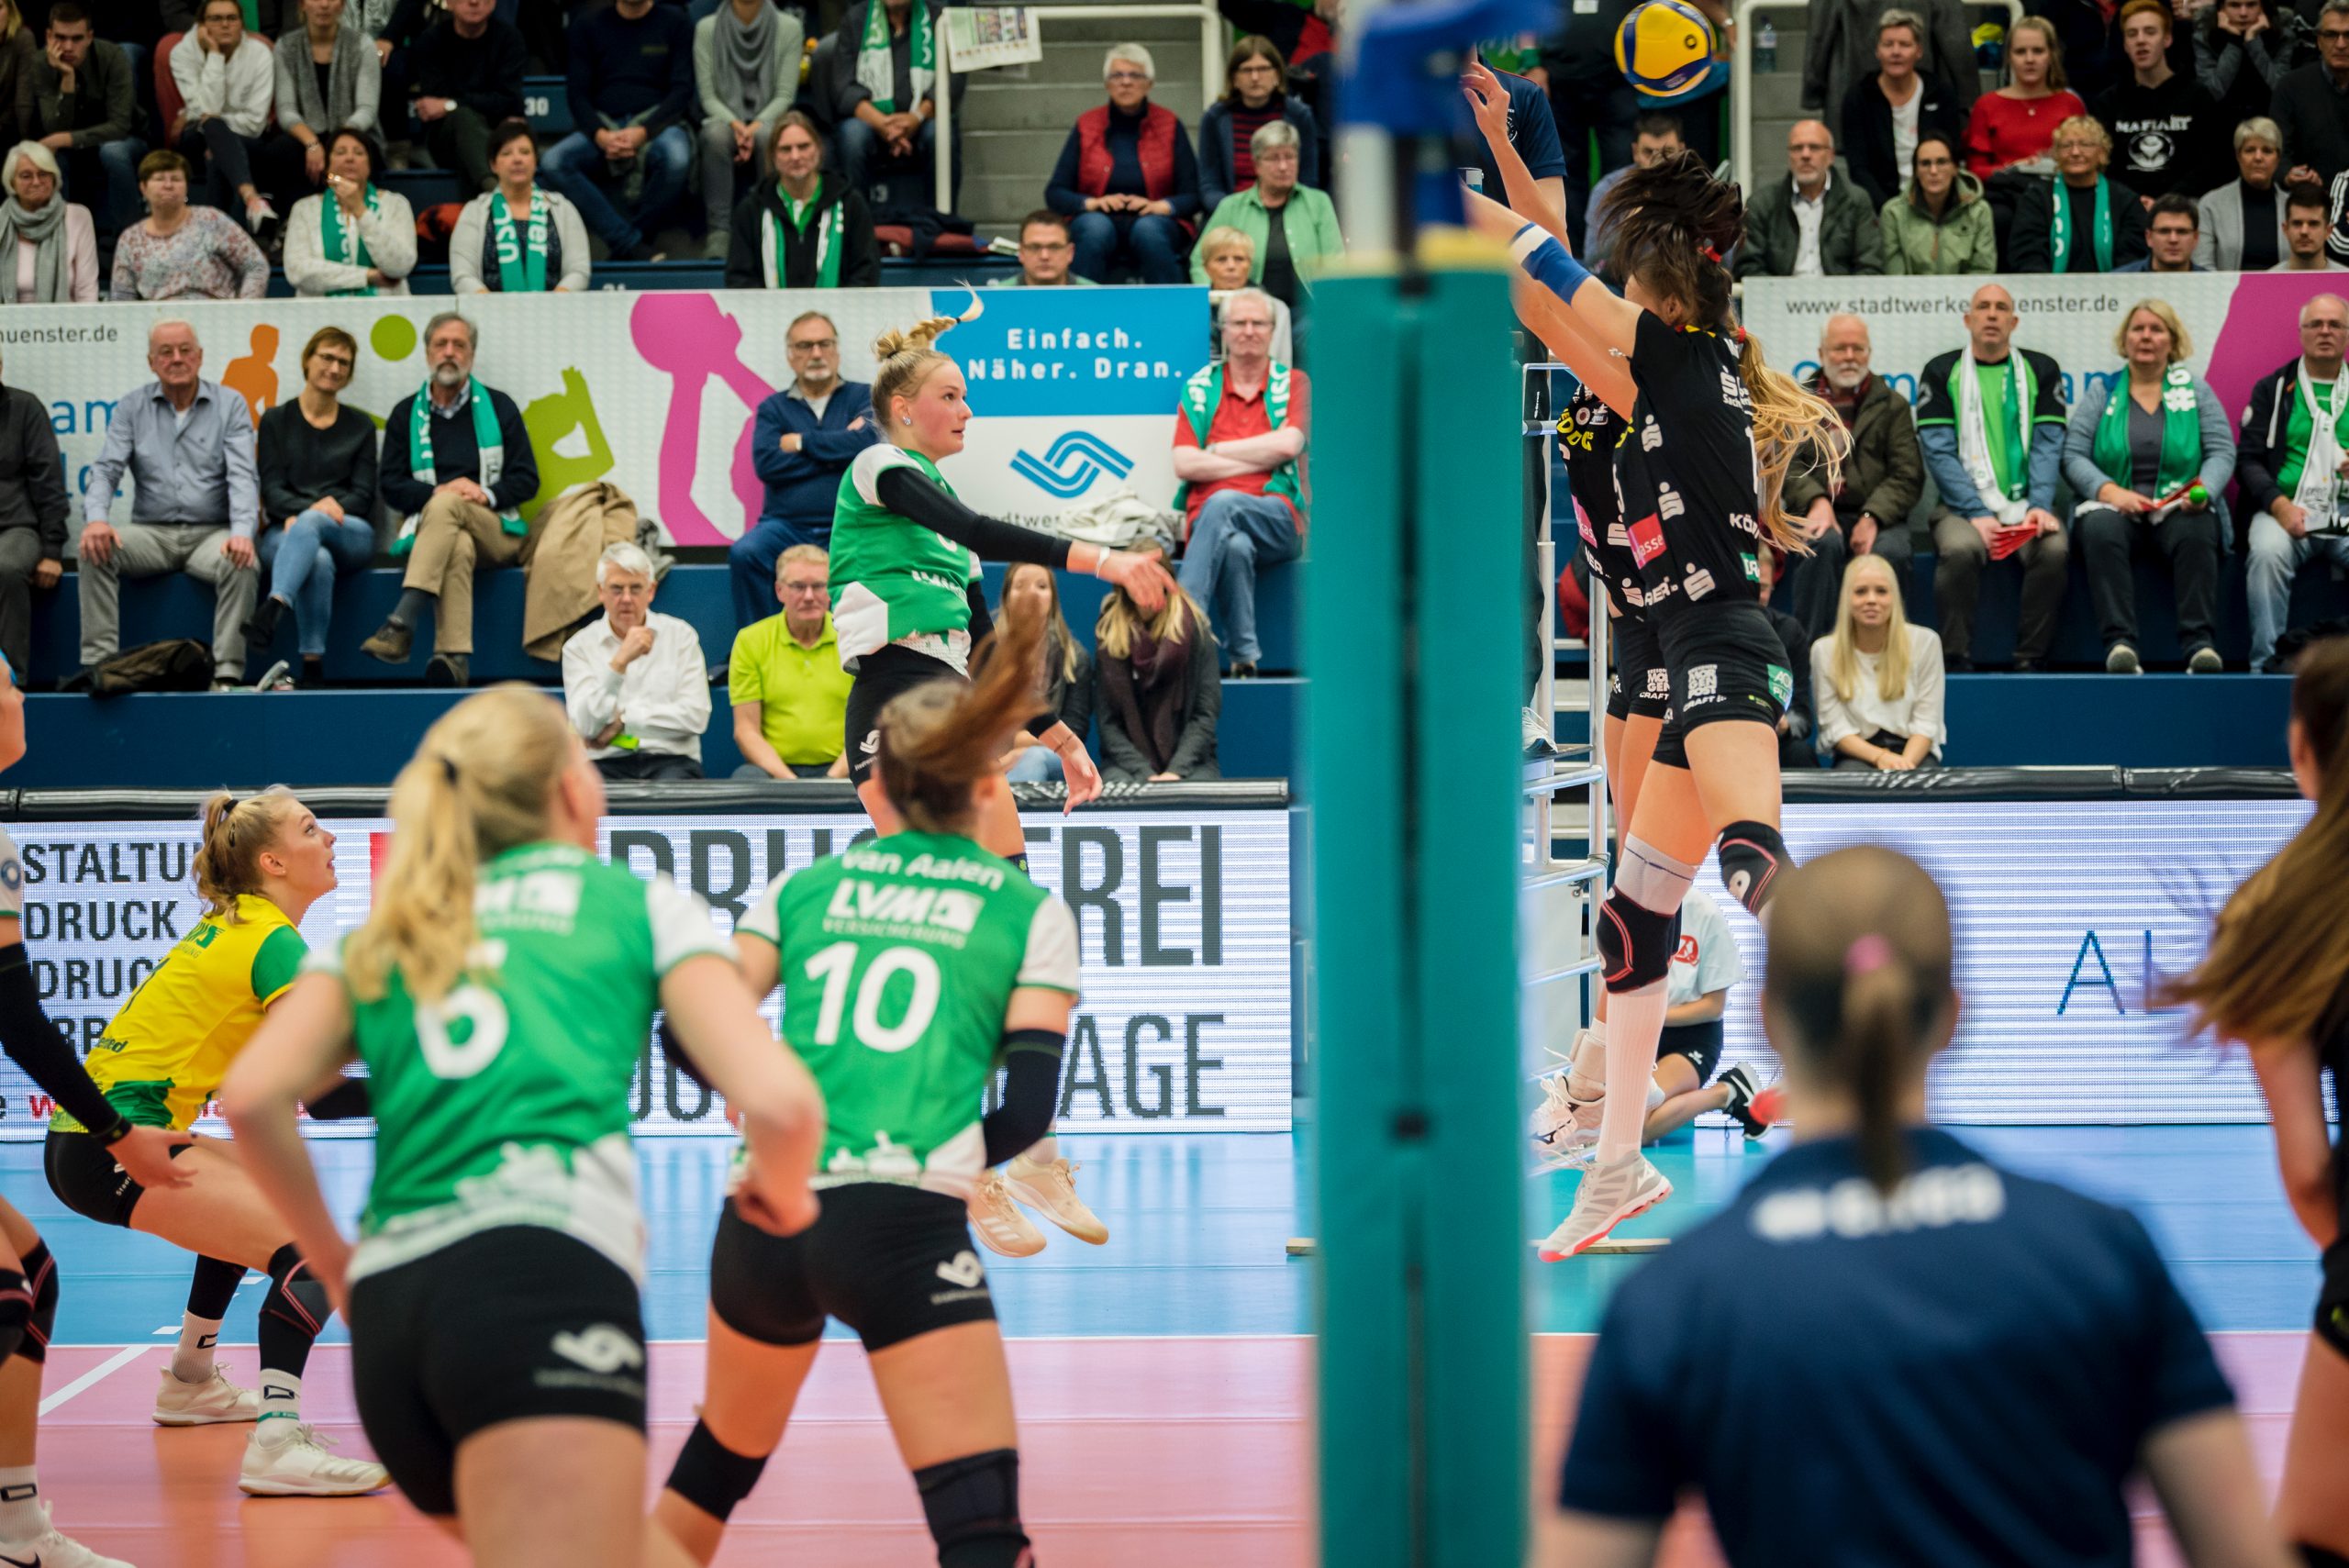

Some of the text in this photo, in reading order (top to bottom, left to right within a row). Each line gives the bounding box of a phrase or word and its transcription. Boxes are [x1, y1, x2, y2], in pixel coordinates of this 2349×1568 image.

[524, 96, 550, 117] 30
[1787, 294, 2120, 315] www.stadtwerkeenster.de
[0, 324, 118, 344] uenster.de
[1008, 328, 1142, 350] Einfach.
[968, 357, 1183, 380] Näher. Dran.
[22, 842, 200, 884] STALTU
[828, 877, 938, 924] LVM
[25, 901, 178, 941] DRUCK
[32, 957, 170, 1000] DRUC
[804, 941, 941, 1053] 10
